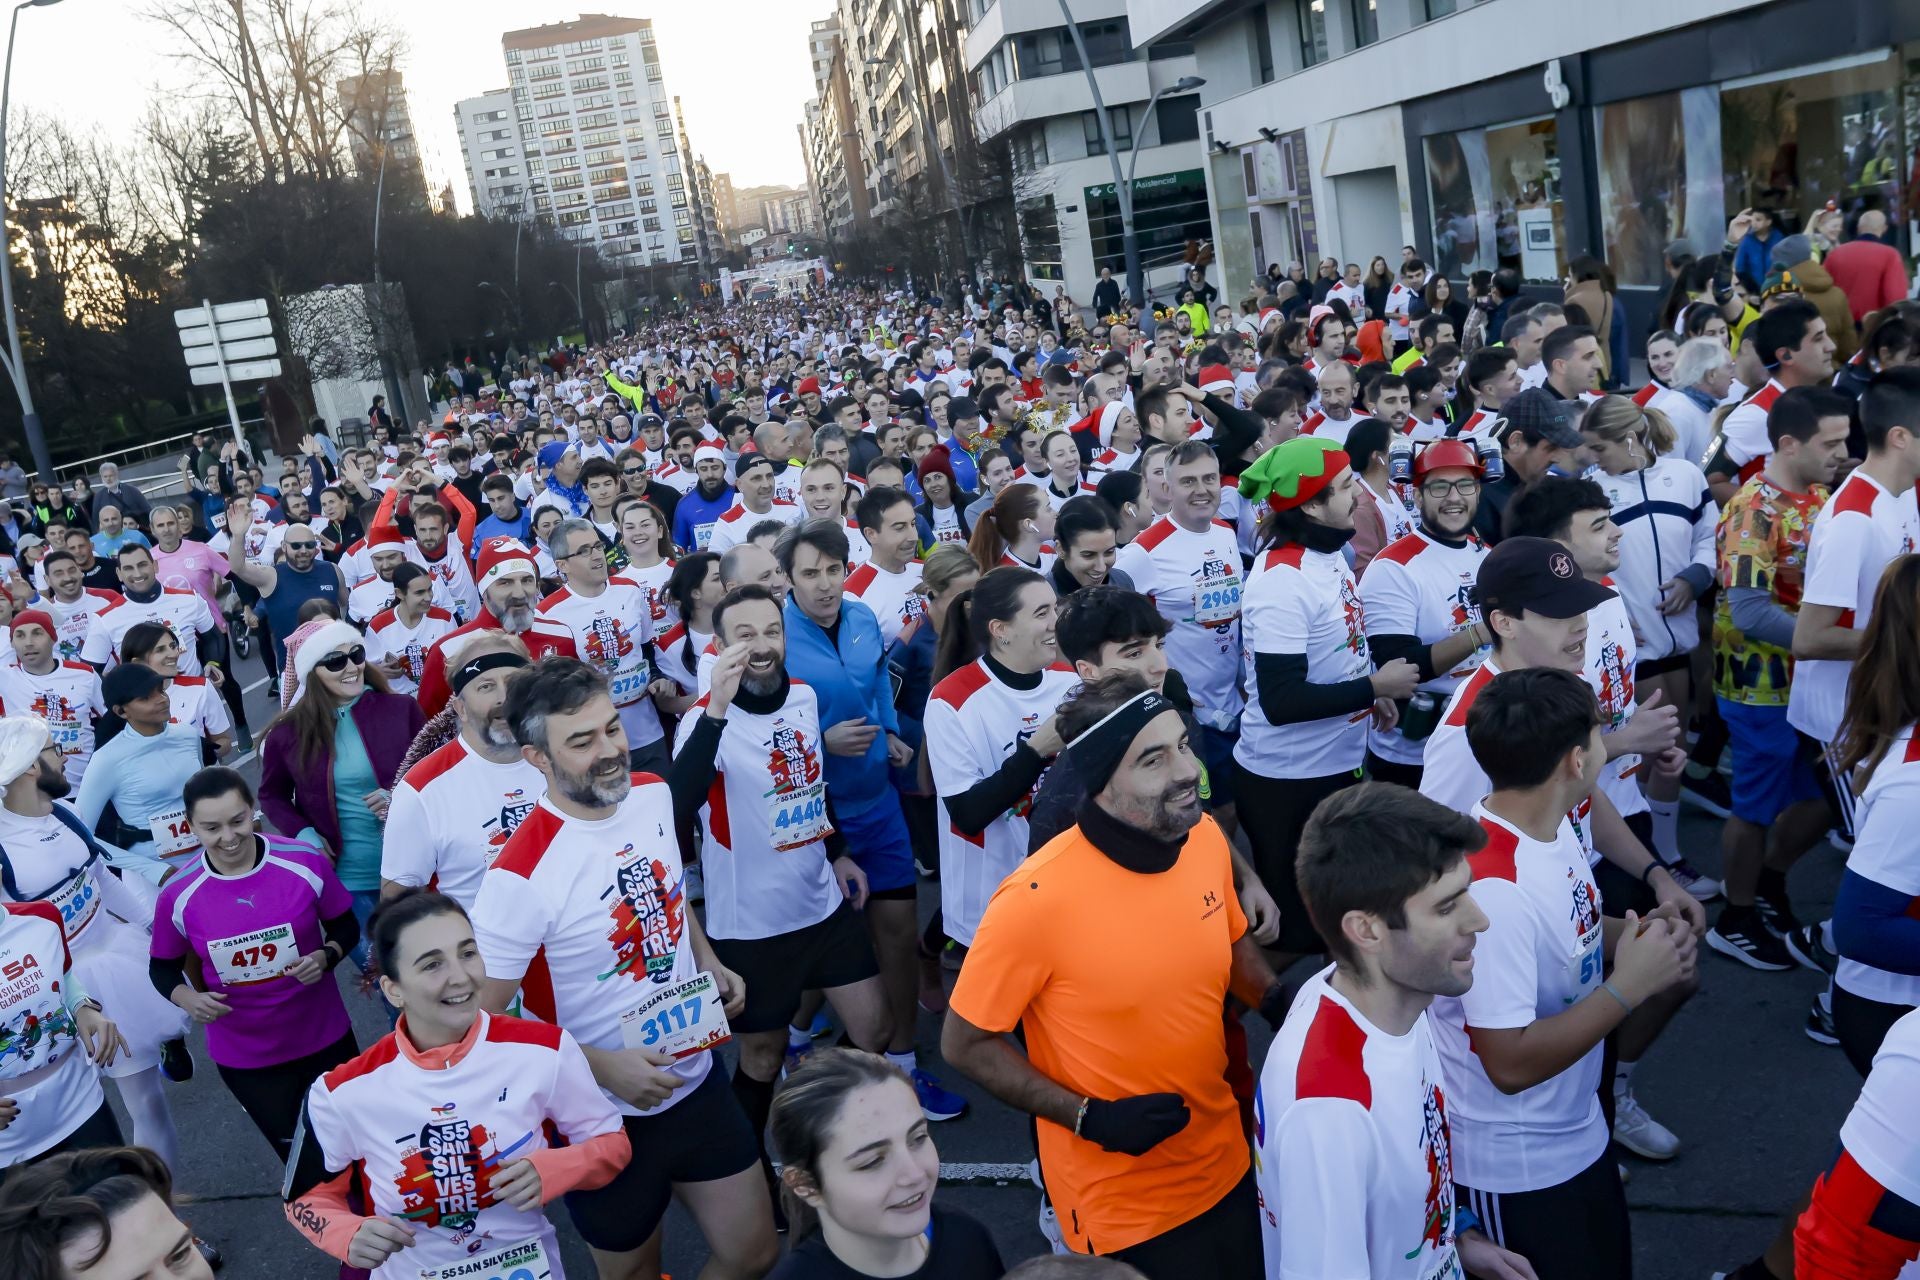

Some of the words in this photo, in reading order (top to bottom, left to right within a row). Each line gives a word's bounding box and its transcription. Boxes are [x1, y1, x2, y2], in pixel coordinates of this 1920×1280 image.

[1136, 174, 1177, 189] Asistencial
[1212, 561, 1224, 572] 55
[1202, 586, 1240, 610] 2968
[596, 624, 614, 632] SAN
[600, 617, 612, 626] 55
[600, 632, 616, 641] SIL
[602, 640, 618, 651] VES
[602, 650, 620, 659] TRE
[613, 672, 647, 694] 3724
[1608, 668, 1622, 684] SIL
[778, 738, 799, 751] SAN
[782, 728, 796, 740] 55
[784, 750, 805, 760] SIL
[788, 758, 806, 774] VES
[788, 772, 808, 788] TRE
[776, 797, 823, 830] 4440
[632, 858, 650, 882] 55
[52, 894, 66, 904] SAN
[626, 878, 658, 899] SAN
[60, 882, 92, 922] 286
[634, 895, 664, 919] SIL
[641, 908, 668, 938] VES
[224, 940, 232, 948] 55
[234, 936, 248, 946] SAN
[250, 926, 287, 942] SILVESTRE
[641, 929, 676, 957] TRE
[232, 943, 278, 968] 479
[2, 954, 38, 982] 54
[22, 984, 40, 998] 2023
[638, 1004, 648, 1016] 55
[648, 994, 663, 1009] SAN
[663, 975, 710, 1002] SILVESTRE
[640, 996, 703, 1046] 3117
[442, 1122, 470, 1142] 55
[428, 1136, 470, 1156] SAN
[432, 1154, 472, 1178] SIL
[435, 1173, 476, 1197] VES
[434, 1192, 478, 1214] TRE
[442, 1268, 456, 1280] 55
[458, 1262, 482, 1276] SAN
[483, 1242, 538, 1268] SILVESTRE
